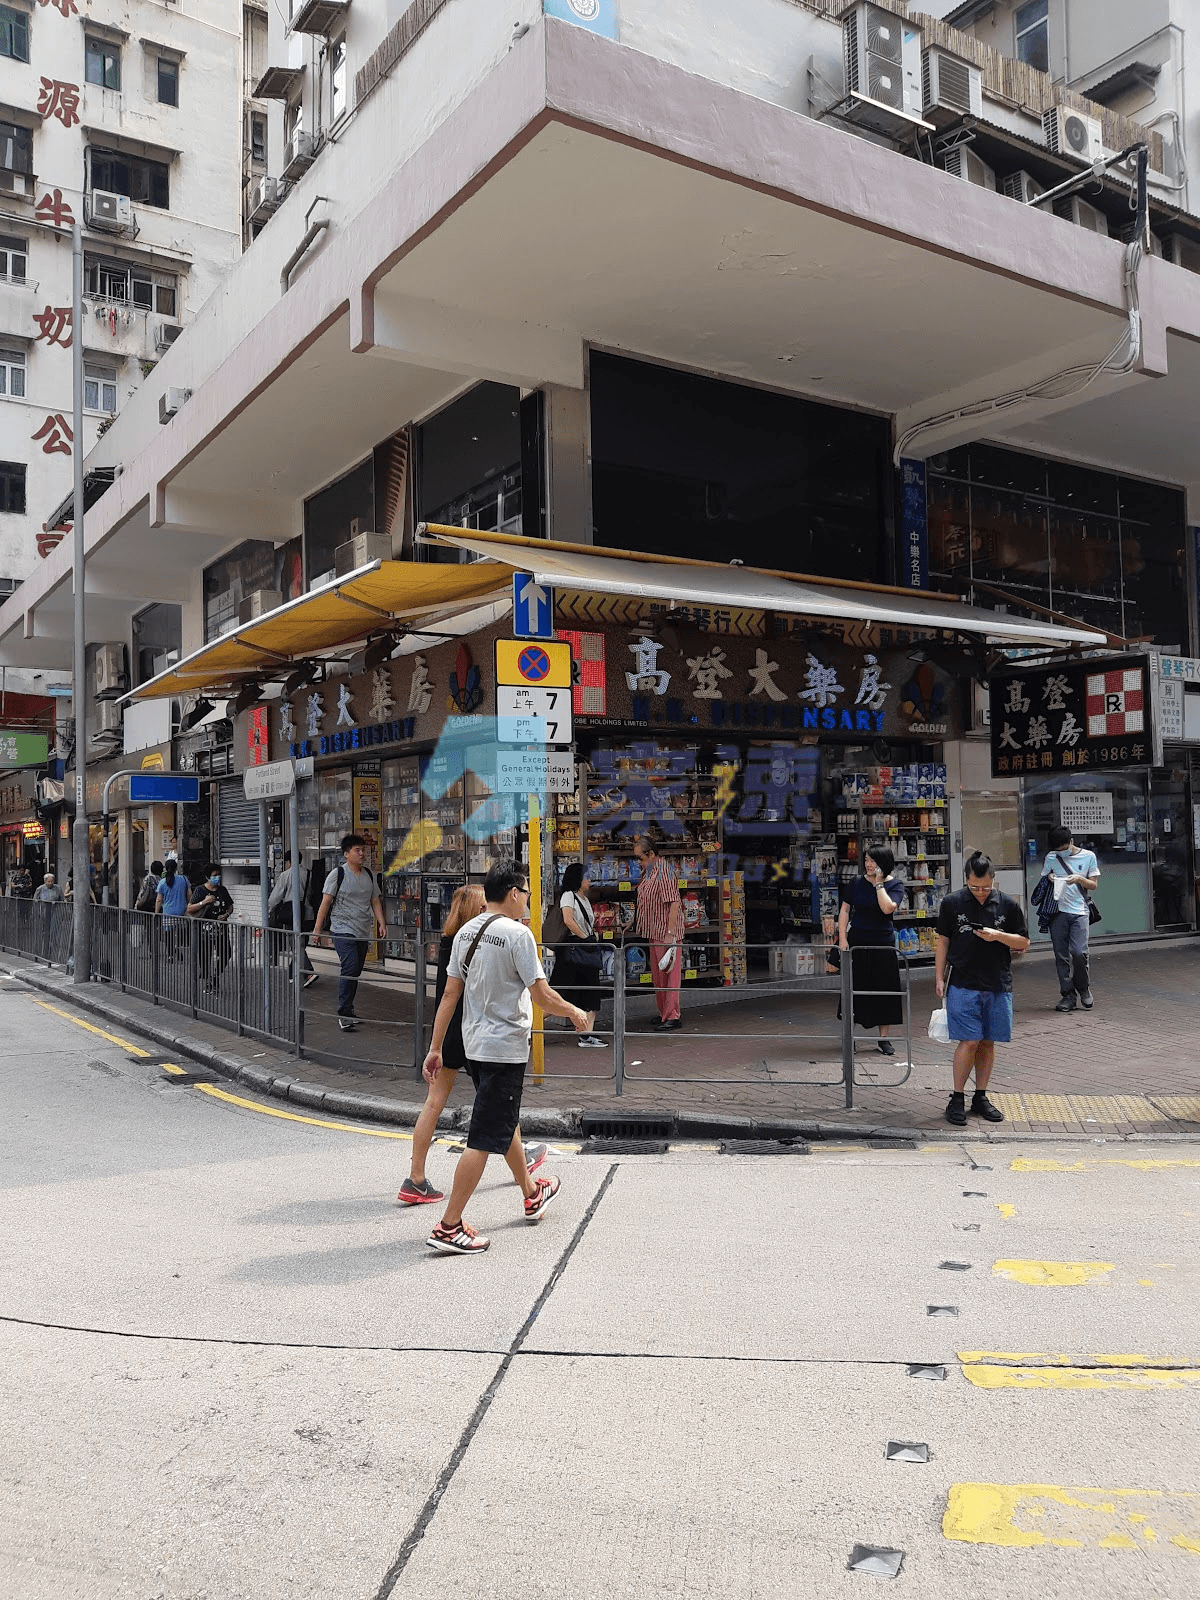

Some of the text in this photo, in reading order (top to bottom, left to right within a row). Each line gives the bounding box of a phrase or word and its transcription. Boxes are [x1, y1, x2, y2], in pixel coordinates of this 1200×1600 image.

[909, 531, 921, 587] 中樂名店
[512, 698, 534, 709] 上午
[546, 692, 558, 710] 7
[512, 728, 534, 739] 下午
[546, 721, 558, 739] 7
[909, 722, 947, 734] GOLDEN
[319, 716, 416, 756] DISPENSARY
[522, 755, 550, 764] Except
[998, 743, 1145, 771] 政府註冊 創於1986年
[501, 764, 571, 774] General Holidays
